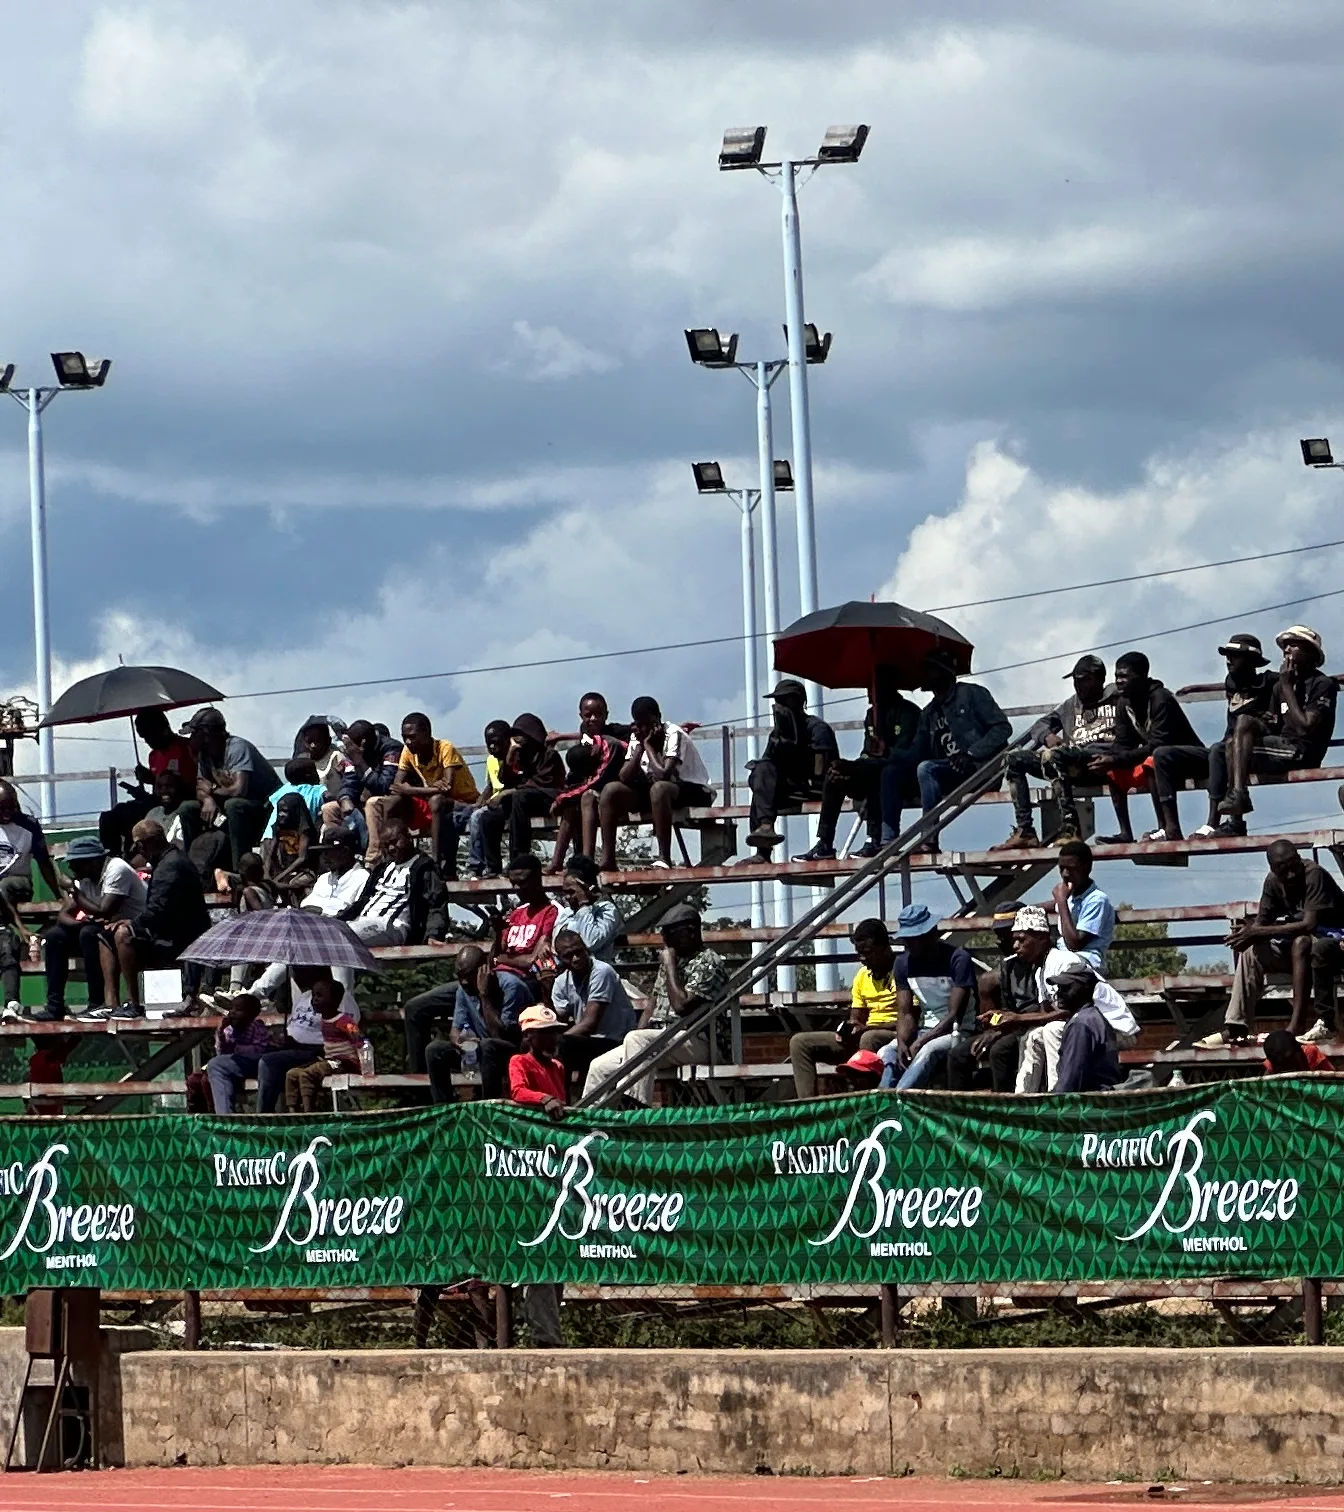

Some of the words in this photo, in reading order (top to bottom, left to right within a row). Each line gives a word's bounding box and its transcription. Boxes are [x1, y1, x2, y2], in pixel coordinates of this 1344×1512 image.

[507, 924, 537, 948] GAP
[484, 1142, 558, 1178] PACIFIC
[771, 1137, 850, 1175] PACIFIC
[1081, 1129, 1164, 1168] PACIFIC
[214, 1151, 286, 1187] PACIFIC
[807, 1119, 983, 1246] Breeze
[1115, 1109, 1299, 1241] Breeze
[0, 1143, 135, 1261] Breeze
[248, 1136, 404, 1253] Breeze
[517, 1130, 684, 1247] Breeze
[45, 1252, 98, 1269] MENTHOL
[305, 1248, 360, 1263] MENTHOL
[579, 1244, 638, 1260] MENTHOL
[870, 1241, 932, 1257] MENTHOL
[1182, 1235, 1248, 1252] MENTHOL
